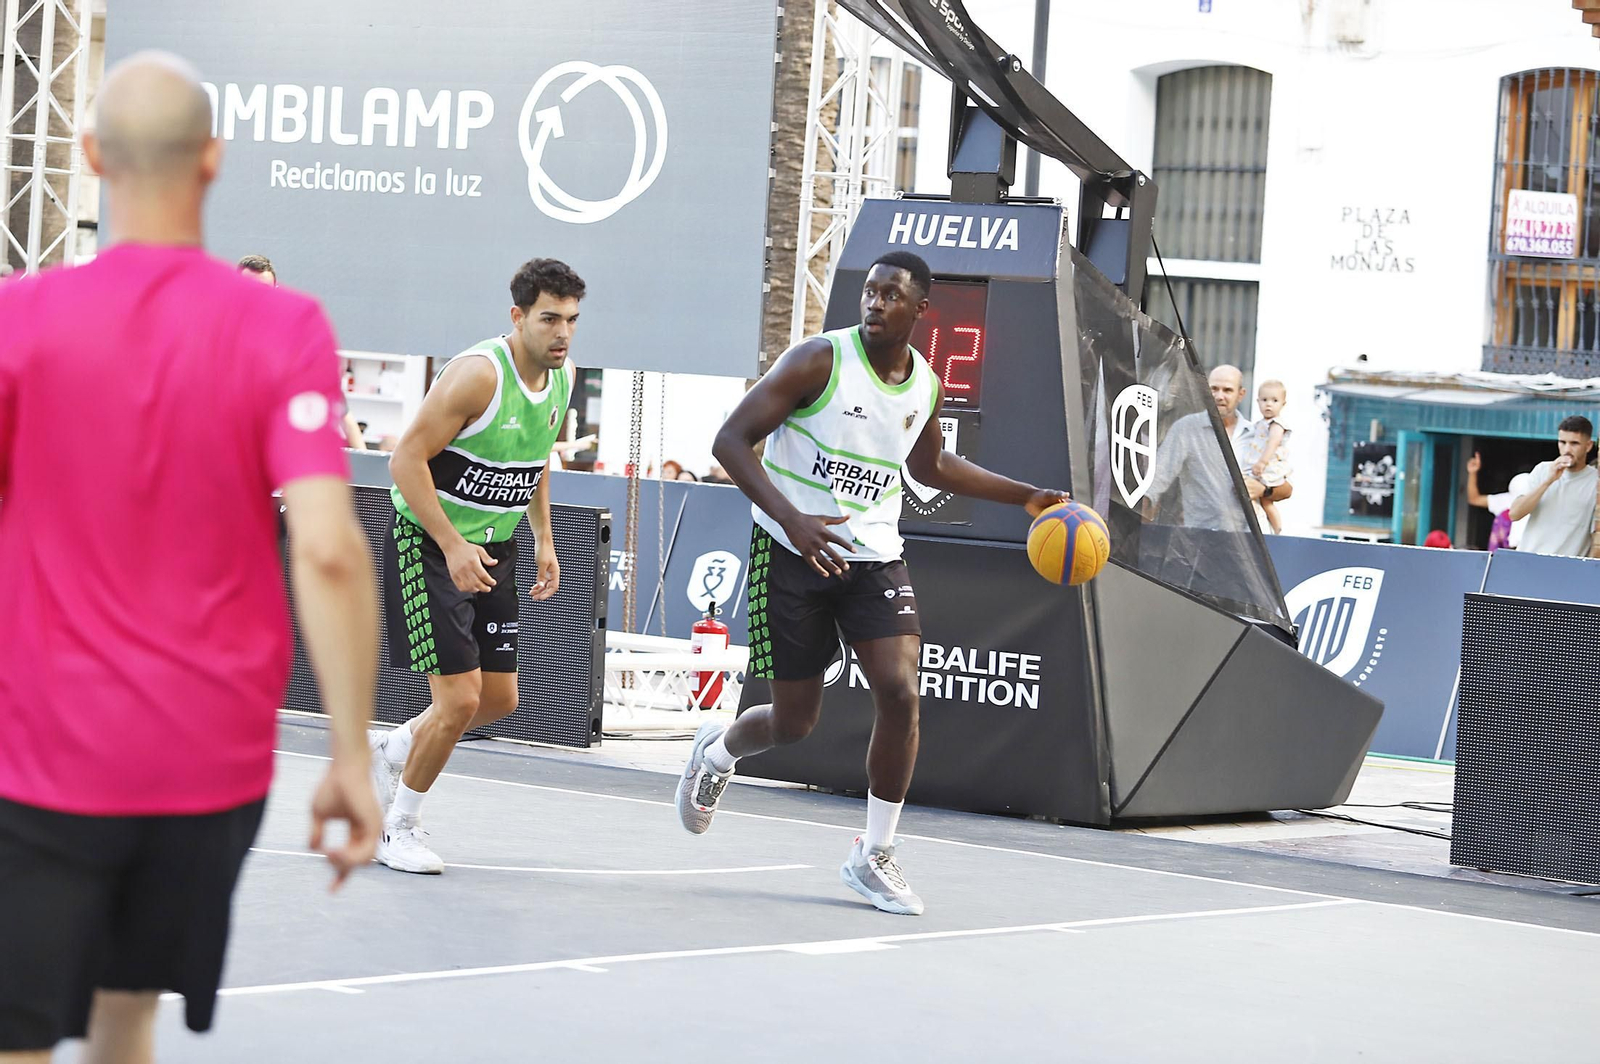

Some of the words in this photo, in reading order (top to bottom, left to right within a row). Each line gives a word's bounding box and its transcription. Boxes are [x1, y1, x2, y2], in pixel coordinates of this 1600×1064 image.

[270, 159, 405, 195] Reciclamos
[414, 166, 437, 196] la
[445, 167, 482, 198] luz
[1341, 206, 1411, 225] PLAZA
[1524, 200, 1574, 216] ALQUILA
[888, 212, 1020, 252] HUELVA
[1362, 223, 1388, 240] DE
[1354, 239, 1395, 256] LAS
[1330, 254, 1416, 274] MONJAS
[939, 422, 954, 432] EB
[484, 526, 495, 544] 1
[1343, 574, 1374, 591] FEB
